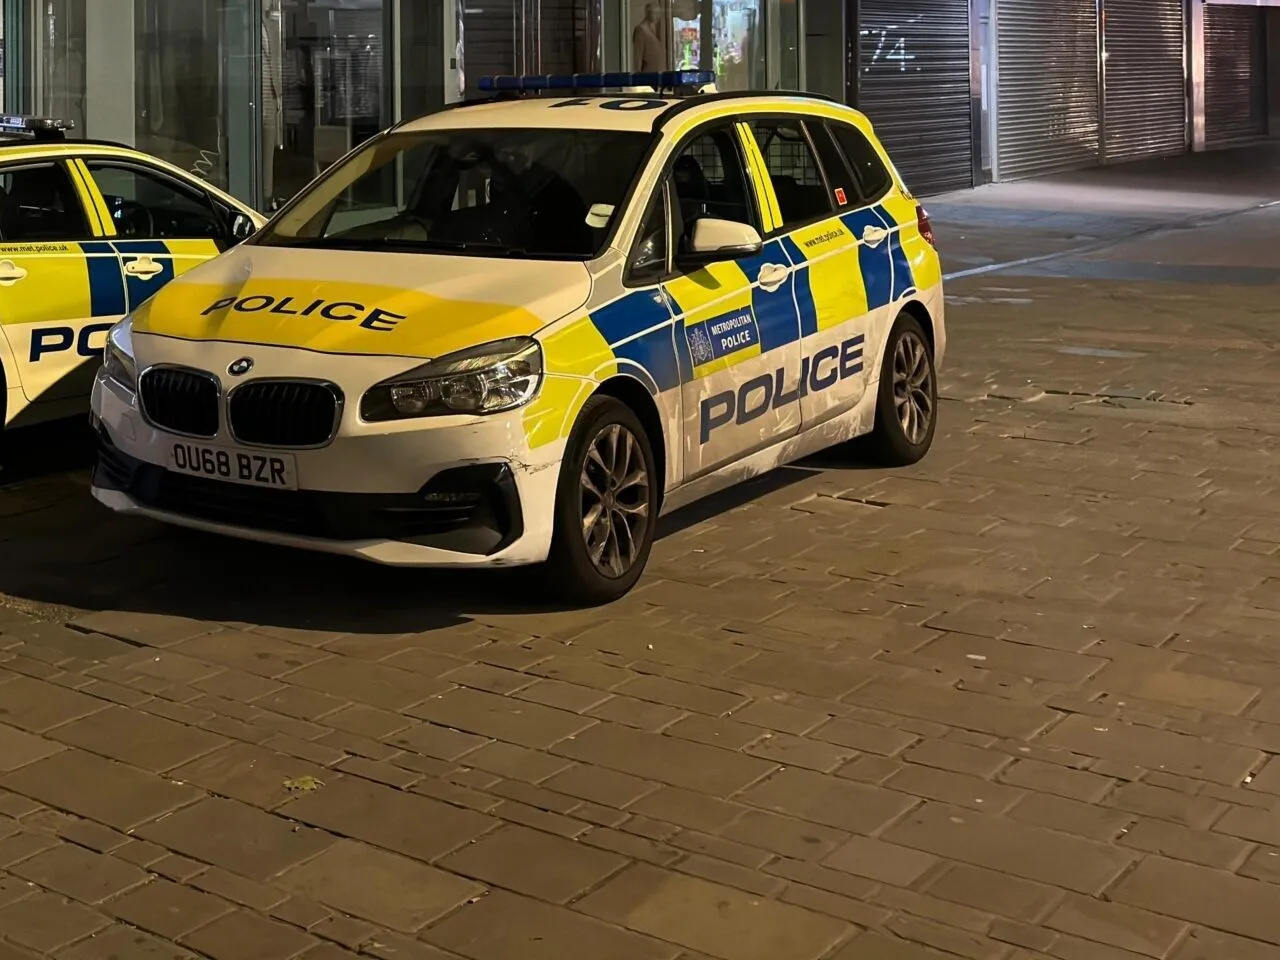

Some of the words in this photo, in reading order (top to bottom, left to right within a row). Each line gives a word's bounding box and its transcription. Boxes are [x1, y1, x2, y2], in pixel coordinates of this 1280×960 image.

[200, 295, 407, 332] POLICE
[711, 313, 752, 336] METROPOLITAN
[721, 329, 751, 351] POLICE
[699, 334, 865, 445] POLICE
[173, 443, 231, 478] OU68
[237, 452, 287, 486] BZR
